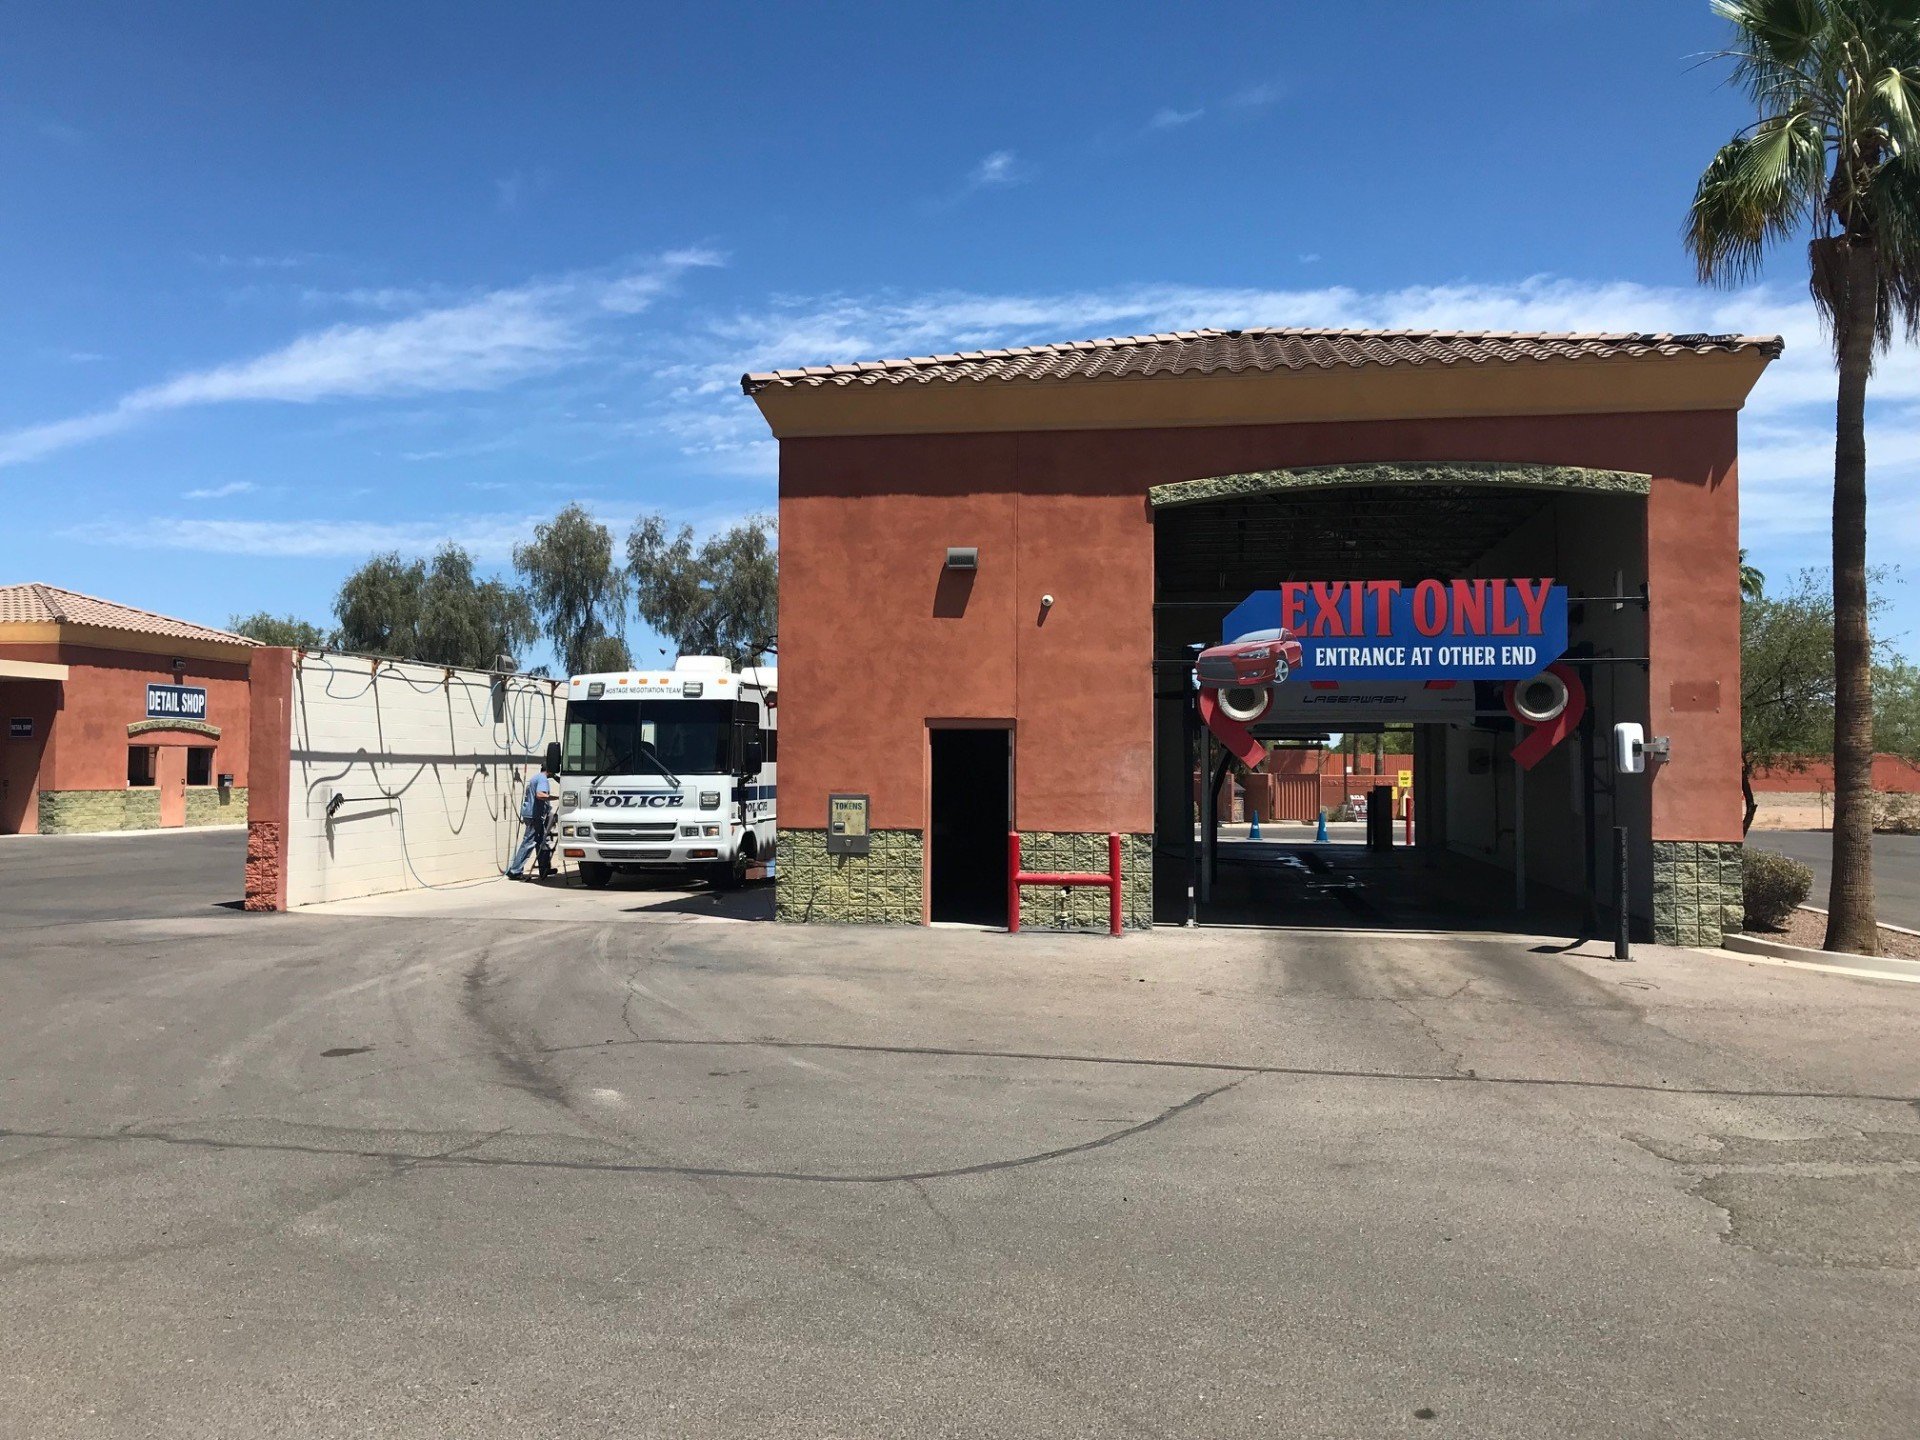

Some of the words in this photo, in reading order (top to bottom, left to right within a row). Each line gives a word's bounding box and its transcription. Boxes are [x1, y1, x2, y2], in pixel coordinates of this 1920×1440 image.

[1279, 580, 1401, 638] EXIT
[1412, 577, 1555, 637] ONLY
[1315, 647, 1406, 667] ENTRANCE
[1410, 646, 1433, 666] AT
[1438, 646, 1496, 666] OTHER
[1501, 646, 1537, 666] END
[149, 690, 180, 712] DETAIL
[181, 692, 205, 713] SHOP
[1302, 695, 1407, 704] LASERWASH
[590, 795, 685, 808] POLICE
[835, 802, 863, 810] TOKENS
